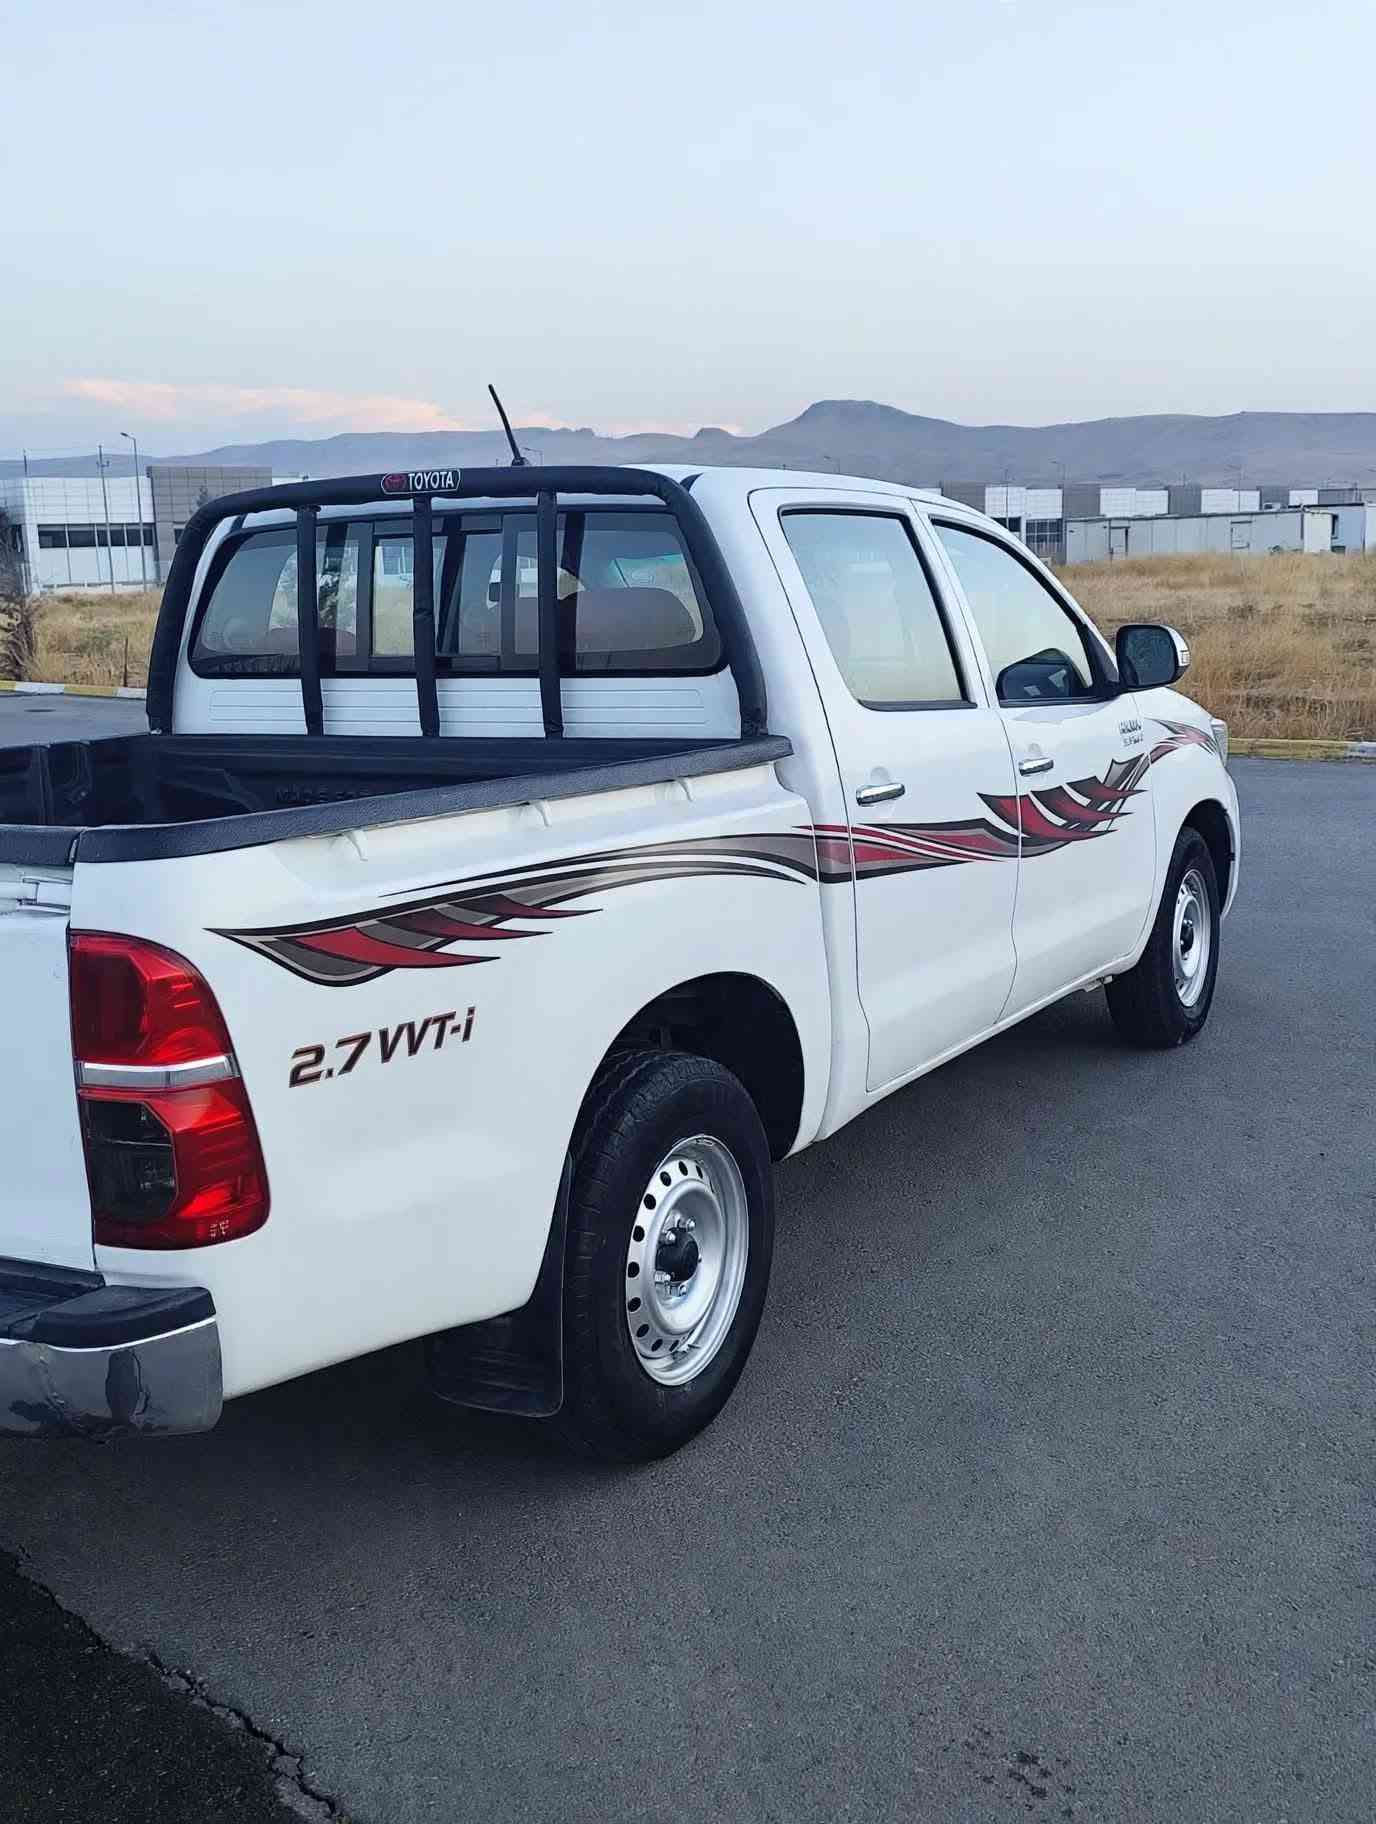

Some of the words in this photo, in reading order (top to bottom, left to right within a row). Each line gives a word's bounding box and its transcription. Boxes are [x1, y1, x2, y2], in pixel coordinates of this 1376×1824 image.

[408, 471, 454, 490] TOYOTA
[289, 1031, 372, 1089] 2.7
[378, 1006, 476, 1065] VVT-i
